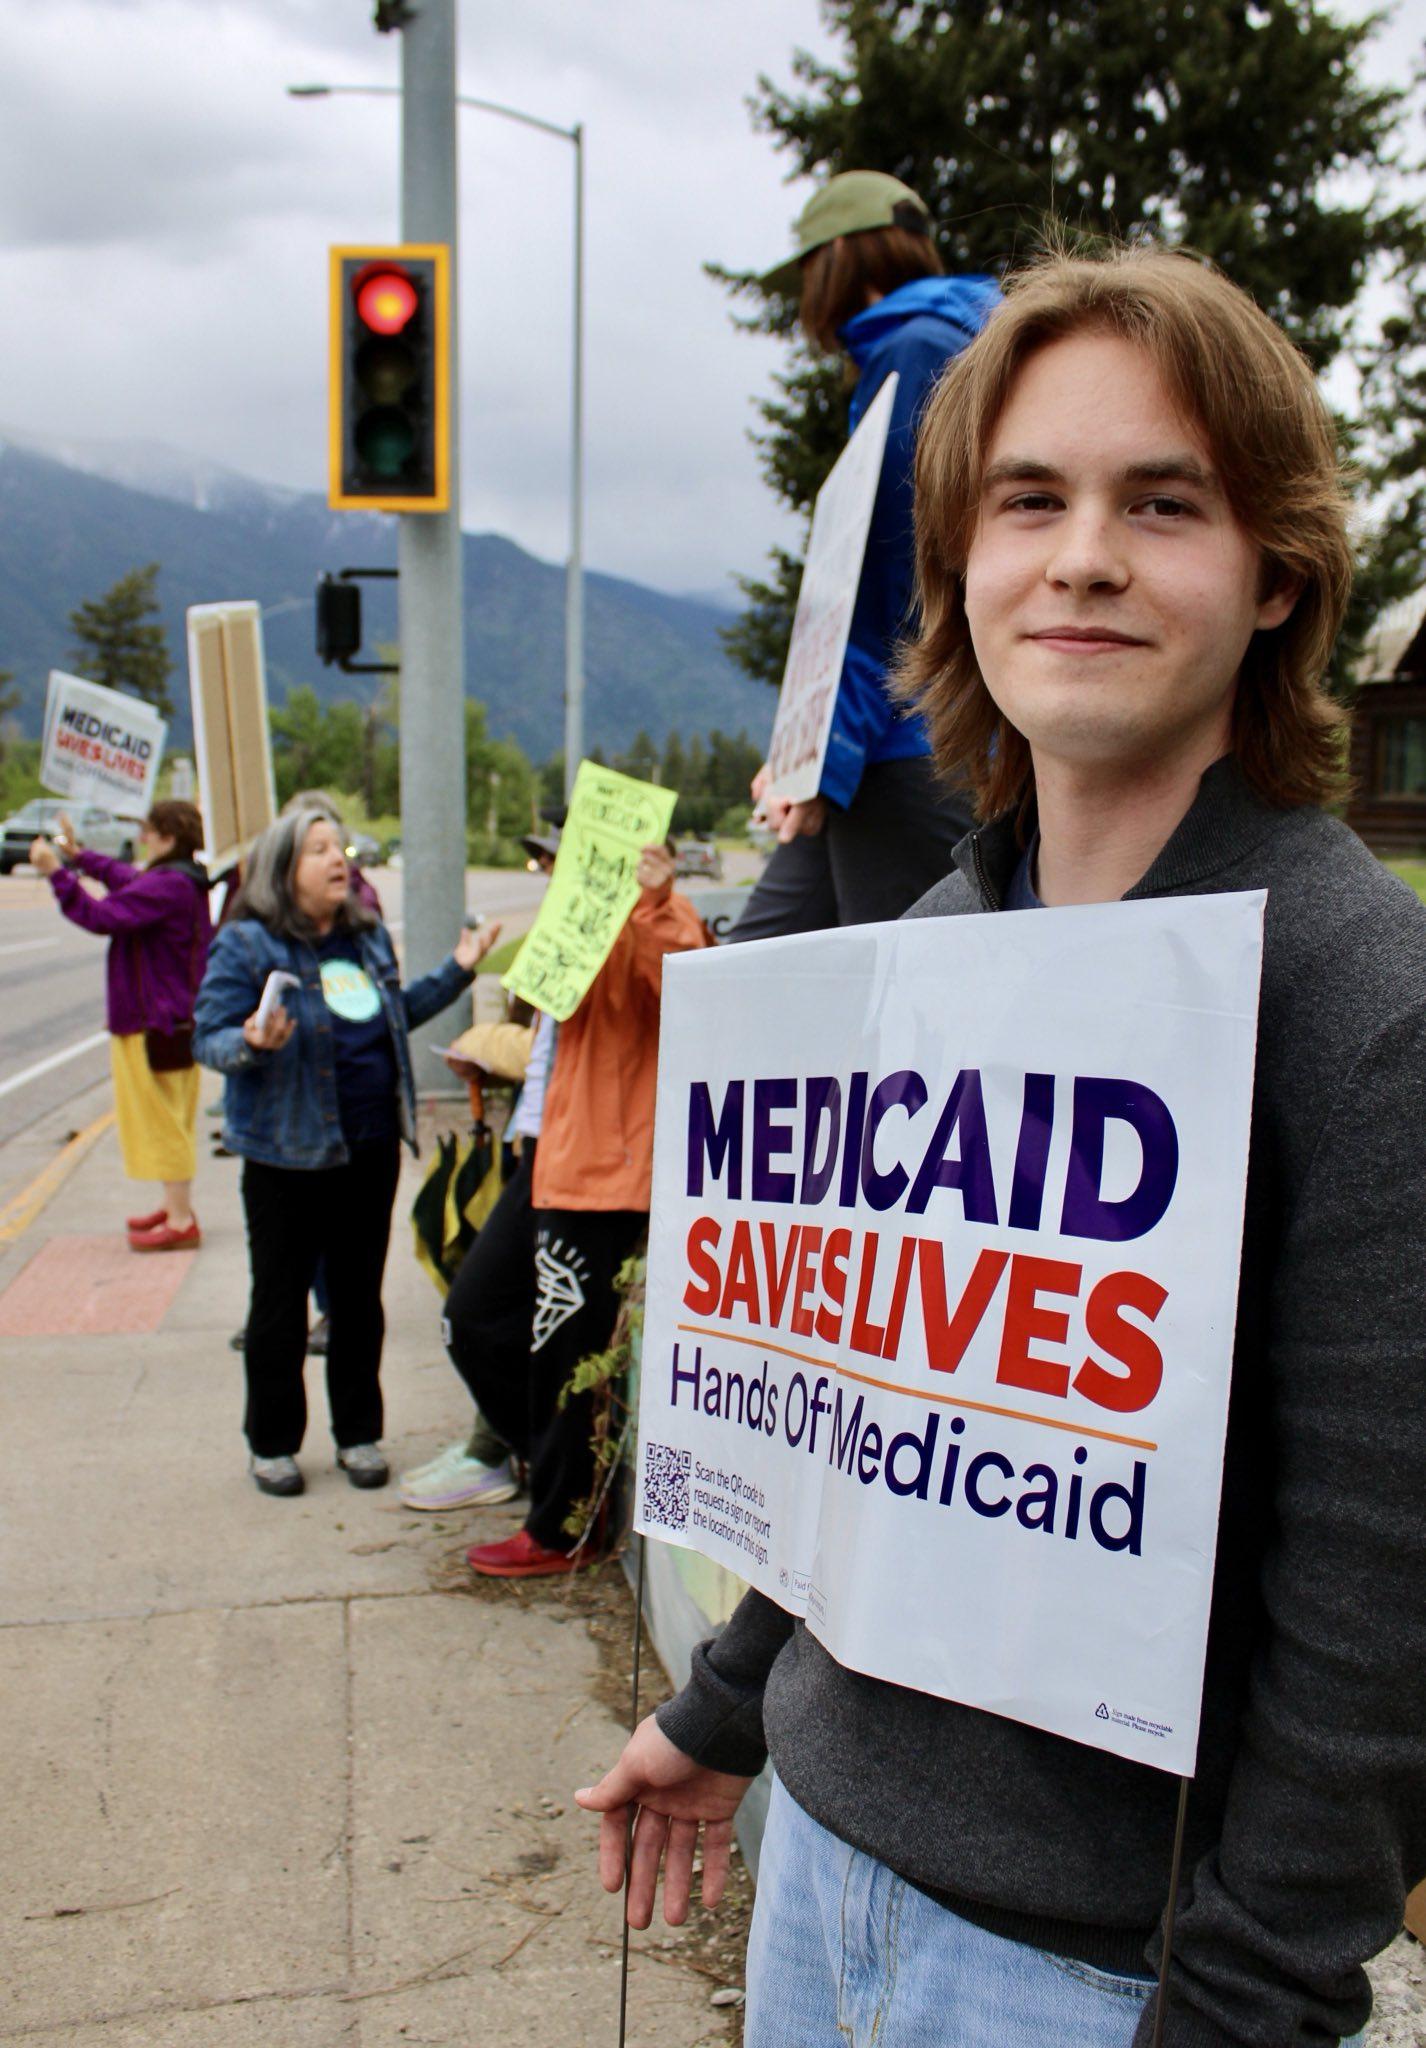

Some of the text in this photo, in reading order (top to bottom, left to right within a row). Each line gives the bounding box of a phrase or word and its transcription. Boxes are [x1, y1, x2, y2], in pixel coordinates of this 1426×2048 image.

[63, 705, 151, 760] MEDICAID
[686, 1068, 1180, 1242] MEDICAID
[683, 1216, 1170, 1413] SAVES LIVES
[670, 1342, 778, 1437] Hands
[829, 1387, 1147, 1557] Medicaid
[695, 1461, 765, 1507] Scan the QR code to
[693, 1508, 769, 1566] the location of this sign.
[694, 1489, 771, 1539] request a sign or report
